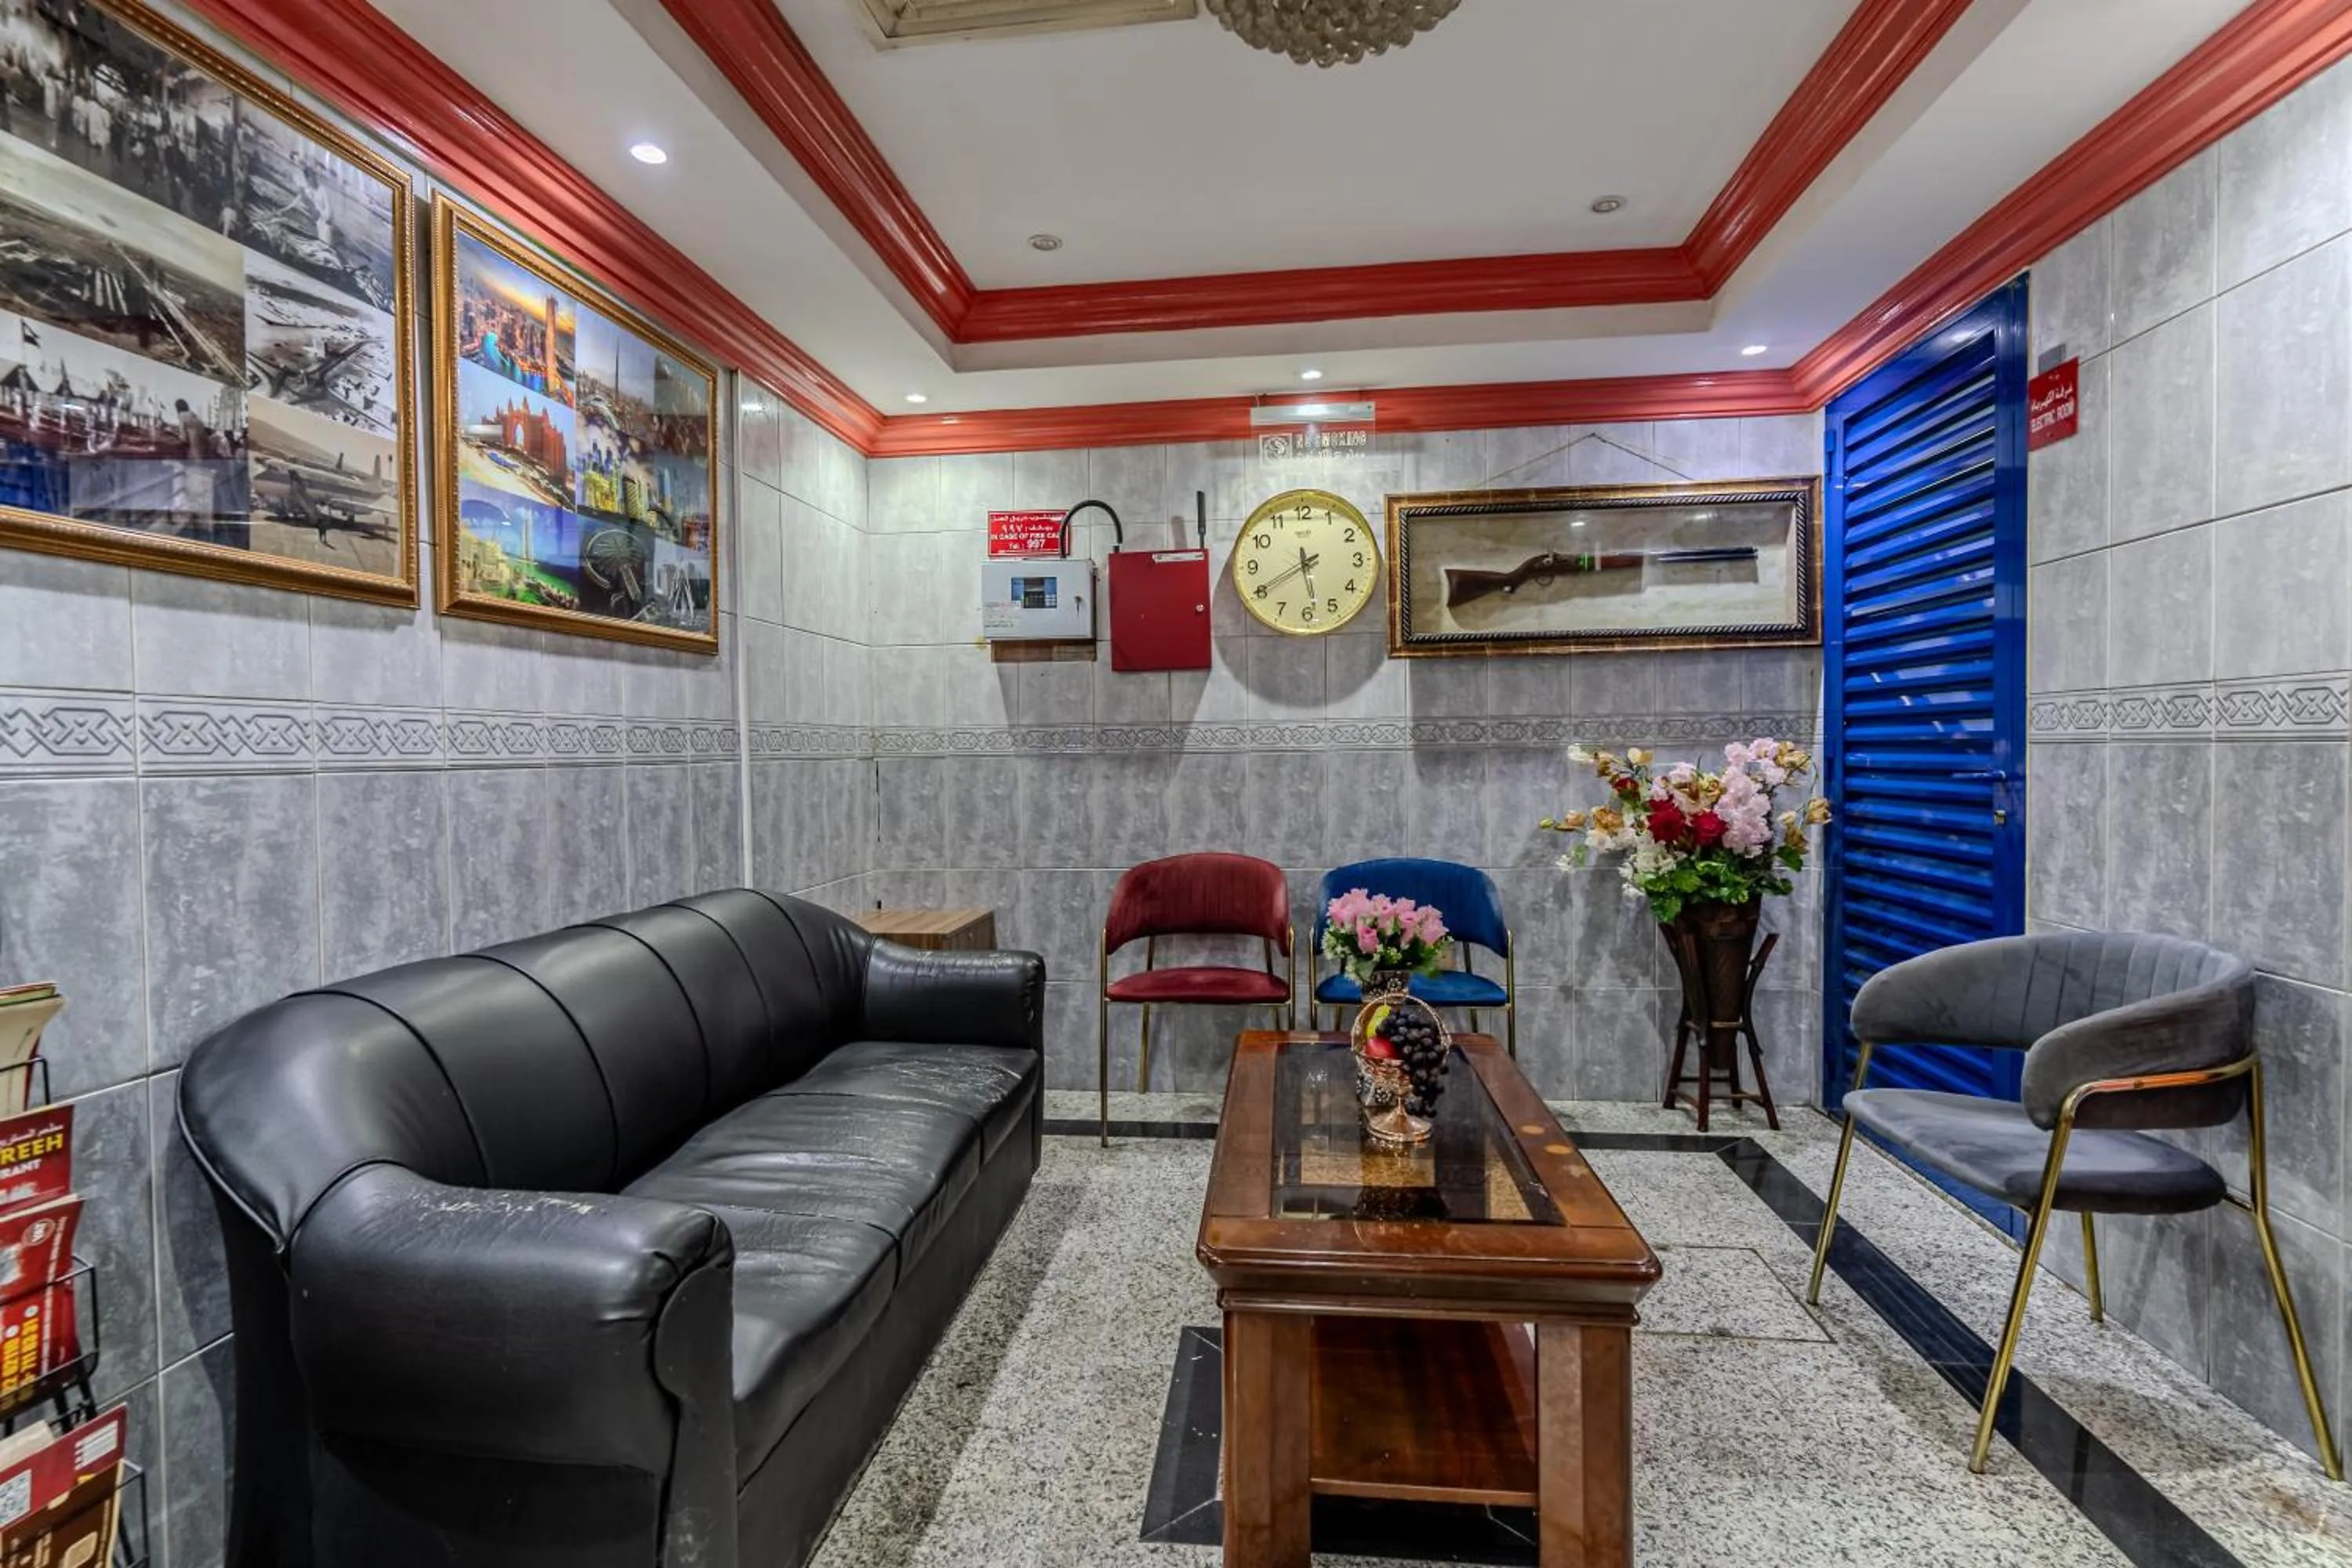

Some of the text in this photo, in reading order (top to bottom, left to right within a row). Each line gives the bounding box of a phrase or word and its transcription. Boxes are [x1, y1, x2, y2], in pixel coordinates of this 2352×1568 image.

[2056, 398, 2074, 421] ROOM
[1294, 506, 1312, 521] 12
[1325, 510, 1332, 525] 1
[1270, 514, 1284, 529] 11
[1252, 534, 1271, 549] 10
[1343, 528, 1356, 543] 2
[1247, 560, 1258, 575] 9
[1352, 552, 1364, 568] 3
[1256, 584, 1268, 599] 8
[1345, 579, 1356, 593] 4
[1276, 601, 1287, 615] 7
[1327, 598, 1338, 613] 5
[1301, 607, 1313, 622] 6
